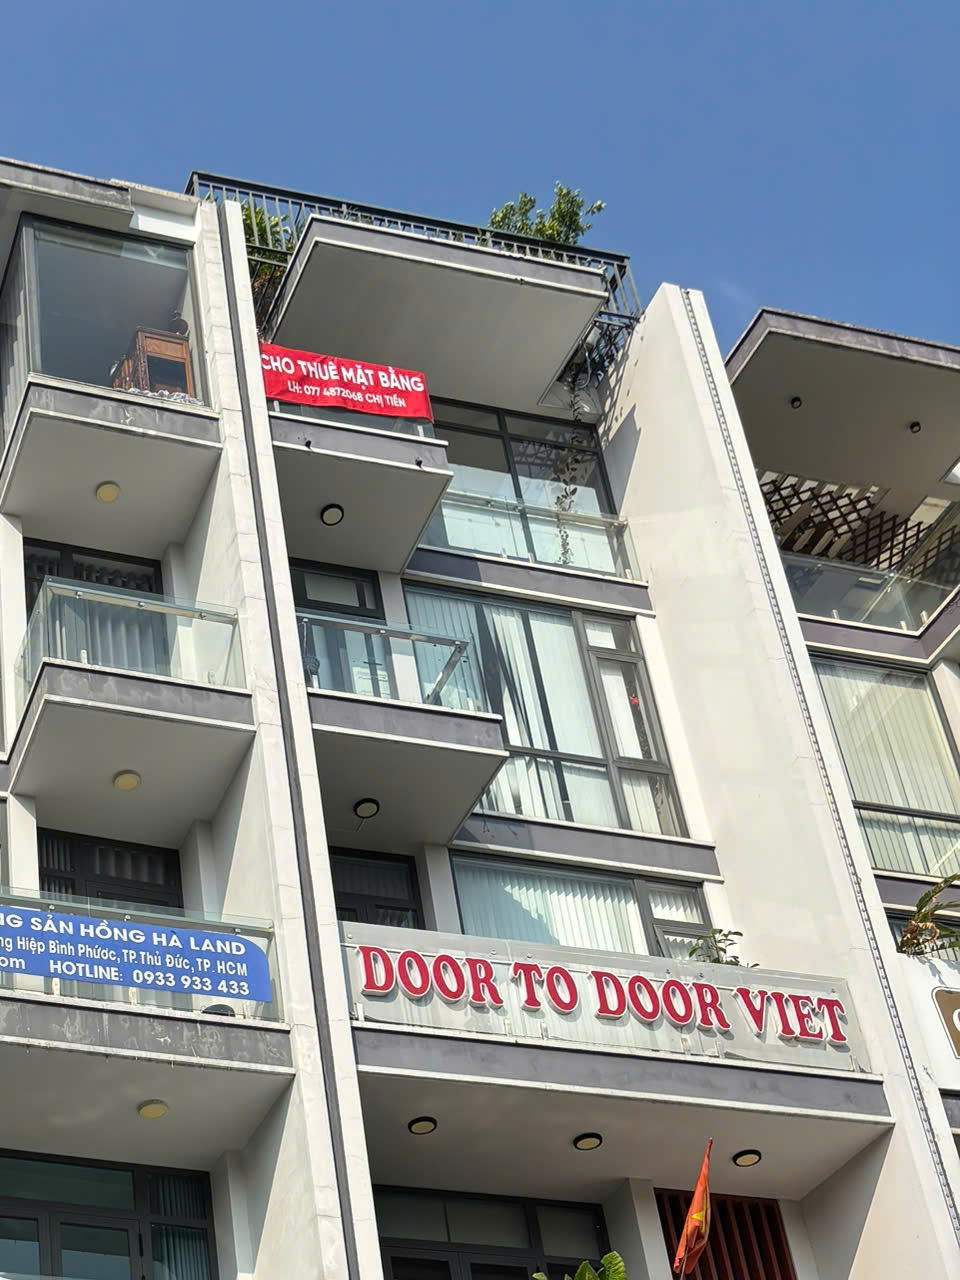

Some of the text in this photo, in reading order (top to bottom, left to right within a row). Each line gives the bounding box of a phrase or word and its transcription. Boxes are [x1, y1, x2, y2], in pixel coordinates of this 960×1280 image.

[261, 354, 425, 392] CHO THUÊ MẶT BẰNG
[16, 935, 46, 956] Hiệp
[49, 939, 75, 957] Bình
[165, 953, 195, 974] Đức,
[30, 915, 73, 935] SẢN
[80, 920, 145, 943] HỒNG
[153, 930, 182, 948] HÀ
[190, 937, 246, 956] LAND
[49, 958, 250, 997] HOTLINE: 0933 933 433
[357, 945, 849, 1045] DOOR TO DOOR VIET
